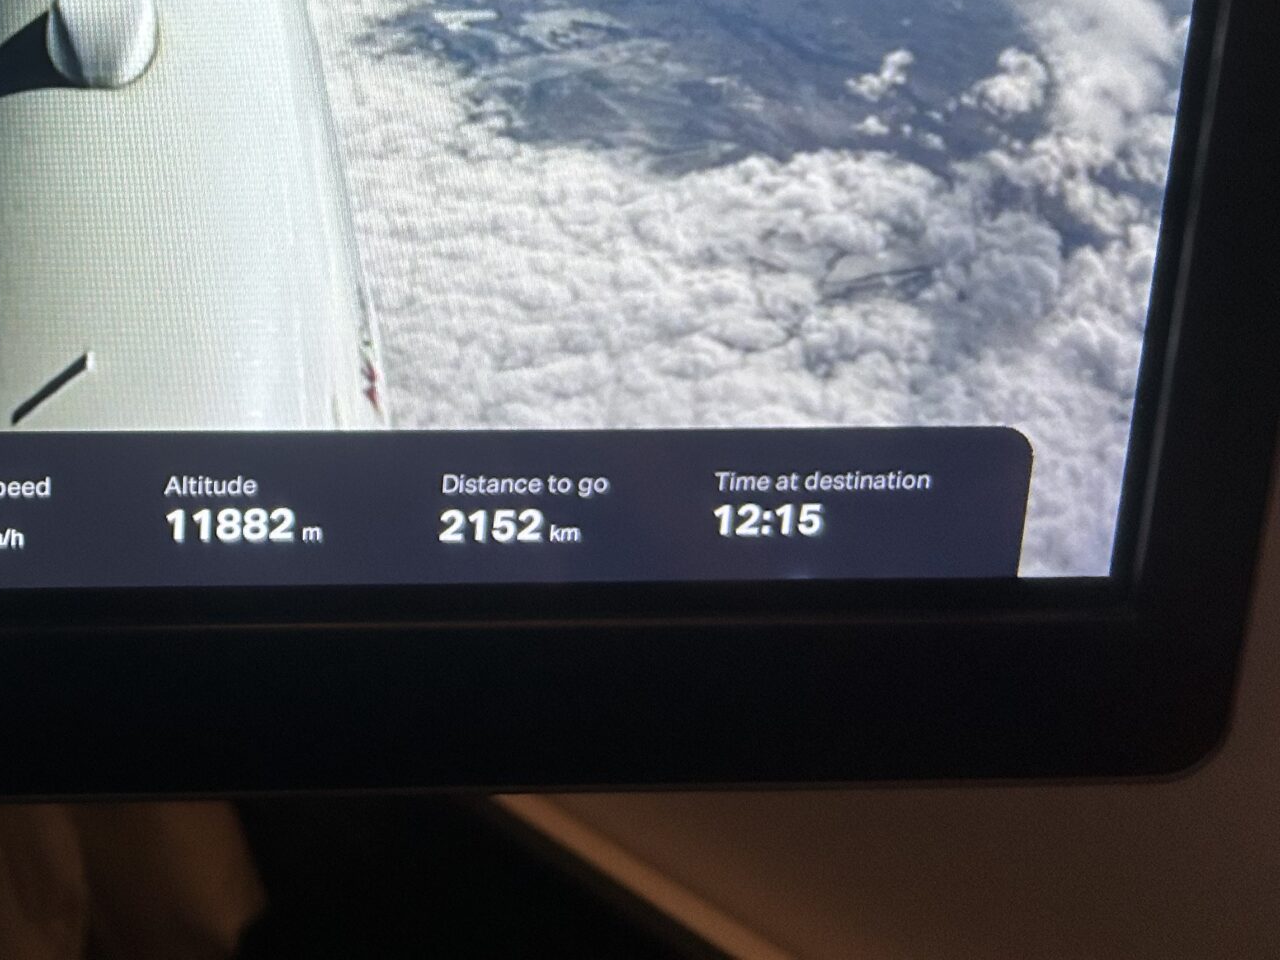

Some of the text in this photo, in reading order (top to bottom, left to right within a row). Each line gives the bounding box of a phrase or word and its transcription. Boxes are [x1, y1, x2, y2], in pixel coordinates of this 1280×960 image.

[163, 475, 258, 497] Altitude
[442, 473, 610, 500] Distance to go
[714, 470, 931, 492] Time at destination
[165, 507, 323, 543] 11882 m
[438, 508, 581, 544] 2152 km
[713, 503, 823, 536] 12:15
